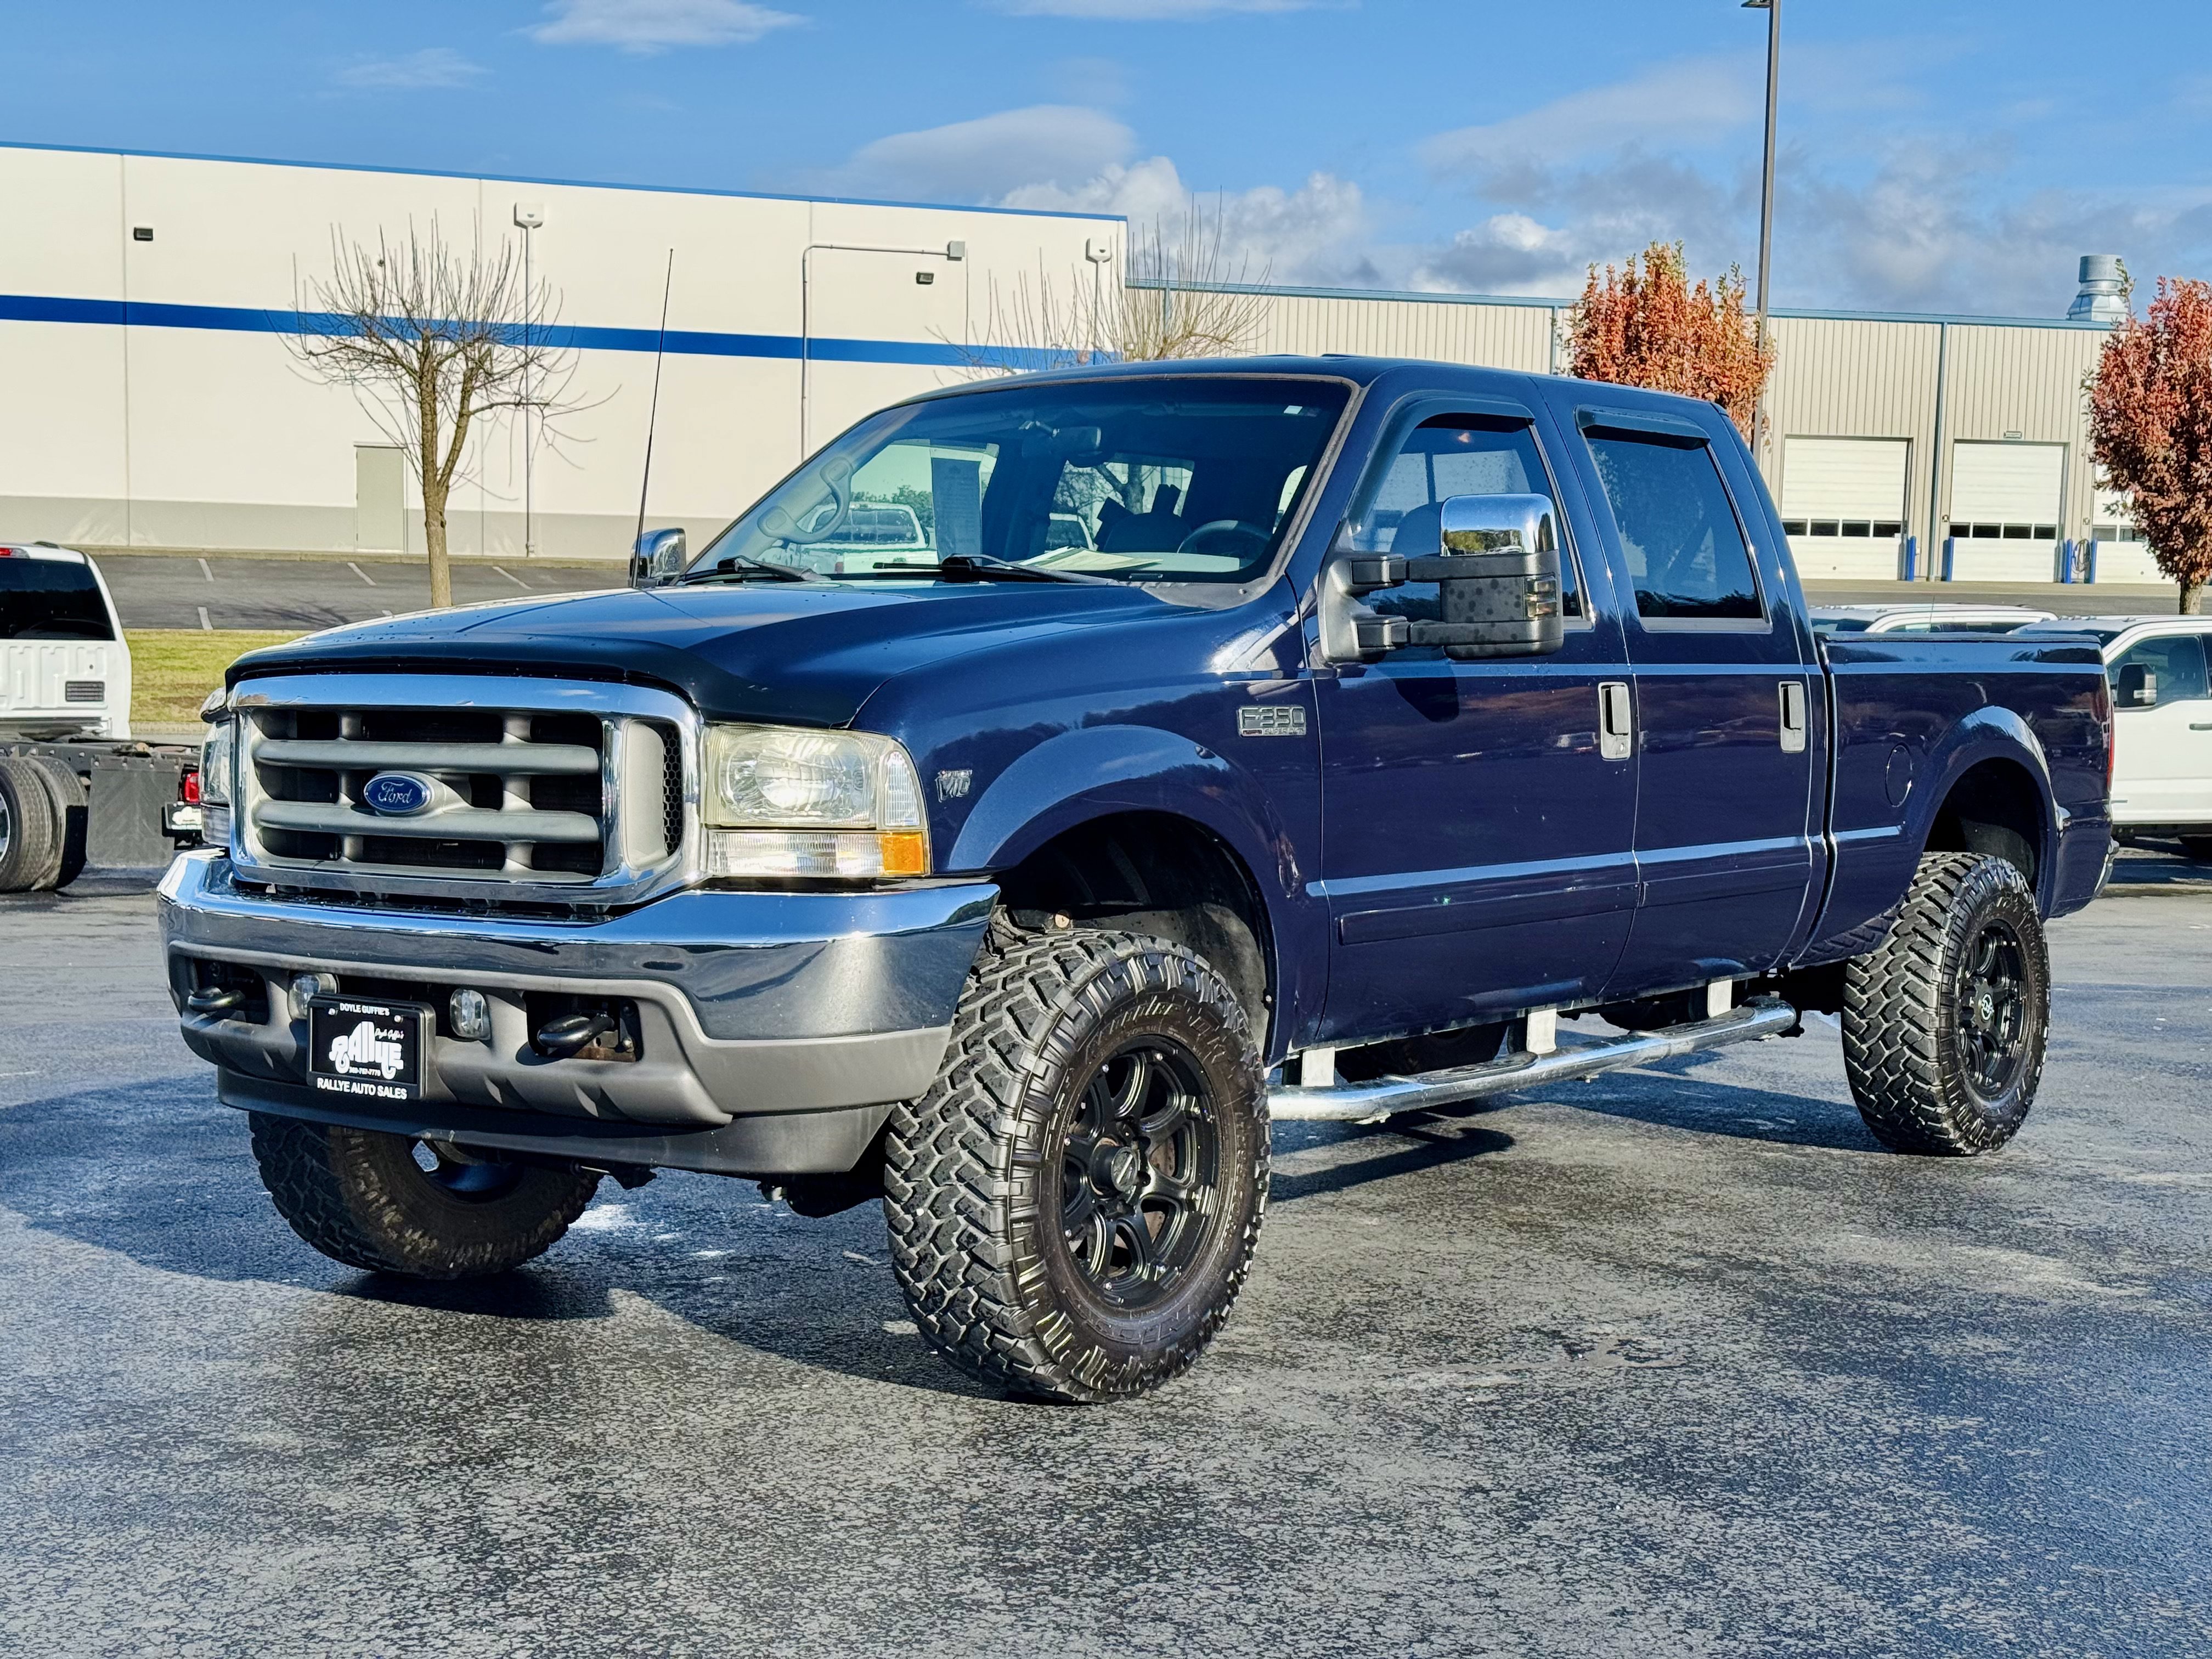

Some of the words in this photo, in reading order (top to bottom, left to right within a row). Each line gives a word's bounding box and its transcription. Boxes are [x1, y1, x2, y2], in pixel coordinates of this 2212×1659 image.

[1238, 707, 1306, 729] F-250
[378, 781, 413, 804] Ford
[340, 1003, 361, 1013] DOYLE
[317, 1077, 350, 1092] RALLYE
[351, 1082, 376, 1095] AUTO
[377, 1086, 407, 1100] SALES
